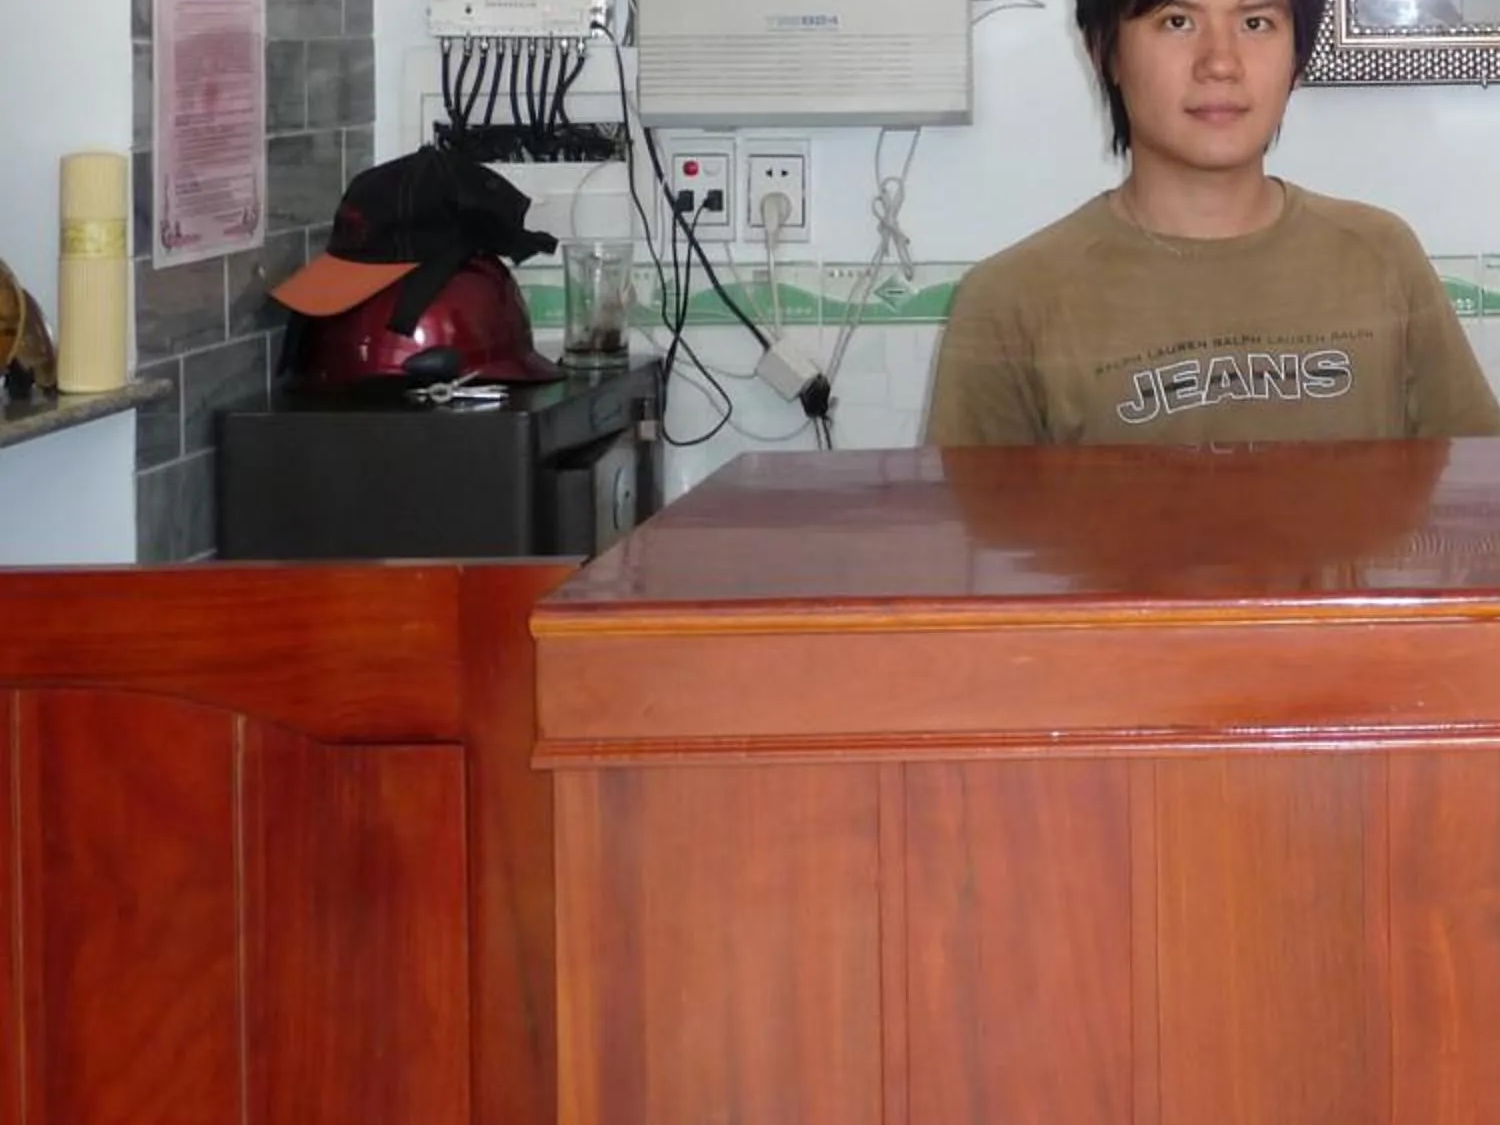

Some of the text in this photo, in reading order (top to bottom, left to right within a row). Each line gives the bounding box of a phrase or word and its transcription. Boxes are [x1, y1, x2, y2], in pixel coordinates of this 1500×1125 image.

[1146, 339, 1208, 361] LAUREN
[1212, 335, 1262, 350] RALPH
[1117, 350, 1353, 424] JEANS
